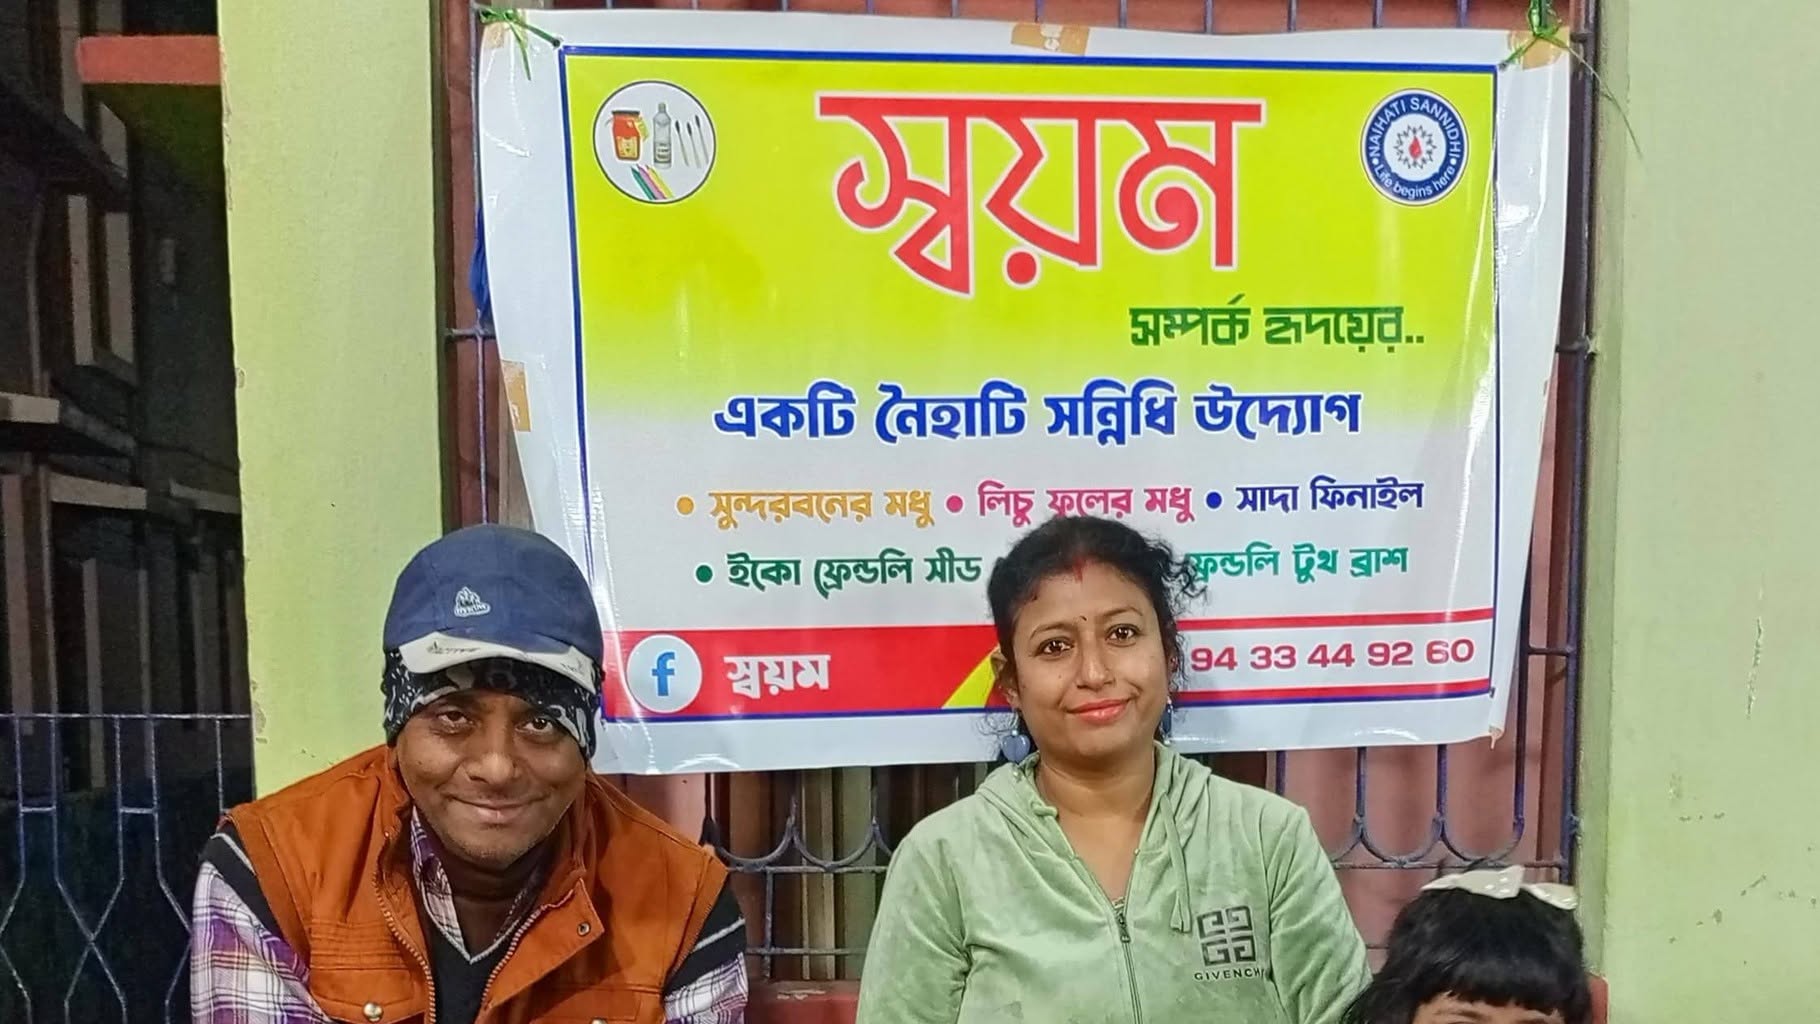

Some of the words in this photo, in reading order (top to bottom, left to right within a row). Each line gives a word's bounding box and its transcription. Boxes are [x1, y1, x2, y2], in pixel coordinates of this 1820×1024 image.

[1368, 99, 1406, 158] NAIHATI
[1409, 97, 1461, 158] SANNIDHI
[817, 95, 1265, 296] স্বয়ম
[1374, 163, 1393, 188] Life
[1393, 182, 1433, 200] begins
[1128, 294, 1251, 347] সম্পর্ক
[714, 380, 856, 439] একটি
[876, 379, 1027, 443] নৈহাটি
[1045, 379, 1177, 445] সন্নিধি
[1195, 384, 1362, 441] উদ্যোগ
[708, 491, 873, 529] সুন্দরবনের
[885, 491, 935, 528] মধু
[977, 480, 1035, 528] লিচু
[1143, 486, 1195, 524] মধু
[1236, 484, 1299, 513] সাদা
[1310, 475, 1424, 512] ফিনাইল
[727, 552, 801, 591] ইকো
[814, 547, 913, 599] ফ্রেন্ডলি
[923, 547, 983, 584] সীড
[1292, 542, 1338, 584] টুথ
[1349, 548, 1409, 577] ব্রাশ
[722, 654, 832, 699] স্বয়ম
[1191, 644, 1238, 672] 94
[1250, 643, 1297, 670] 33
[1306, 642, 1355, 668] 44
[1366, 640, 1414, 666] 92
[1425, 638, 1475, 665] 60
